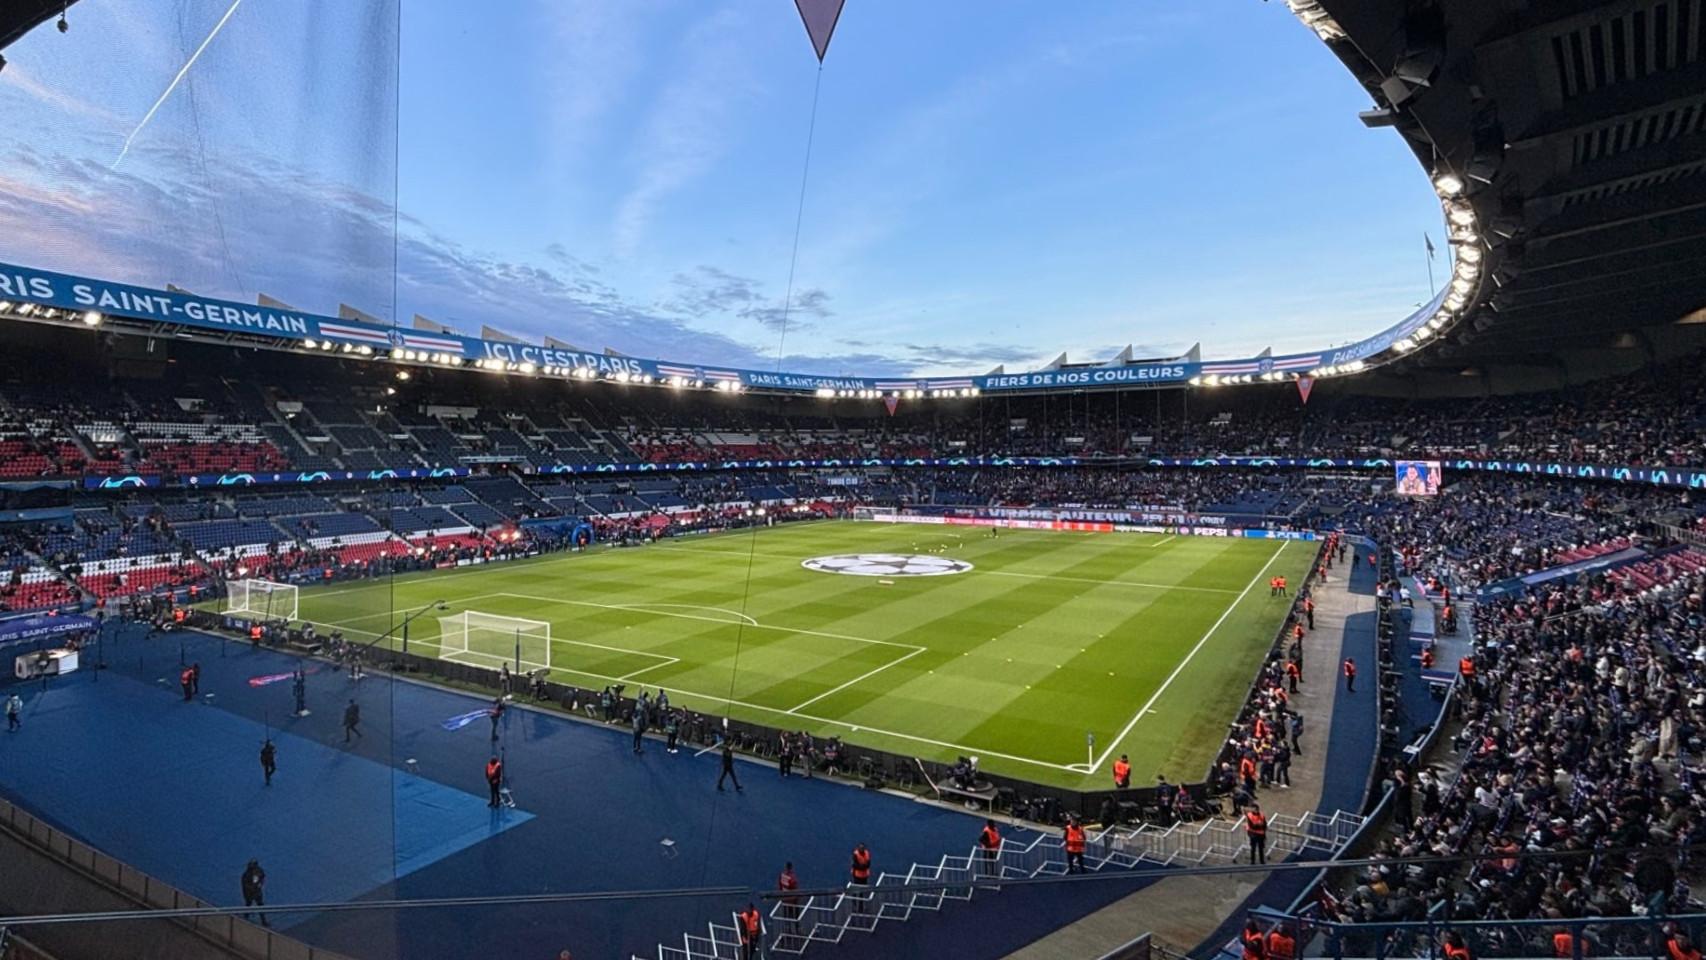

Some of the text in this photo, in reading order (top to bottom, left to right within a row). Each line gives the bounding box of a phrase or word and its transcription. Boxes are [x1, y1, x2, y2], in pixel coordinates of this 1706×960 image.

[72, 284, 307, 334] SAINT-GERMAIN
[484, 342, 642, 375] ICI C'EST PARIS
[750, 374, 865, 390] PARIS SAINT-GERMAIN
[986, 366, 1184, 388] FIERS DE NOS COULEURS
[1194, 527, 1227, 537] PEPSI
[22, 621, 92, 637] SAINT-GERMAIN
